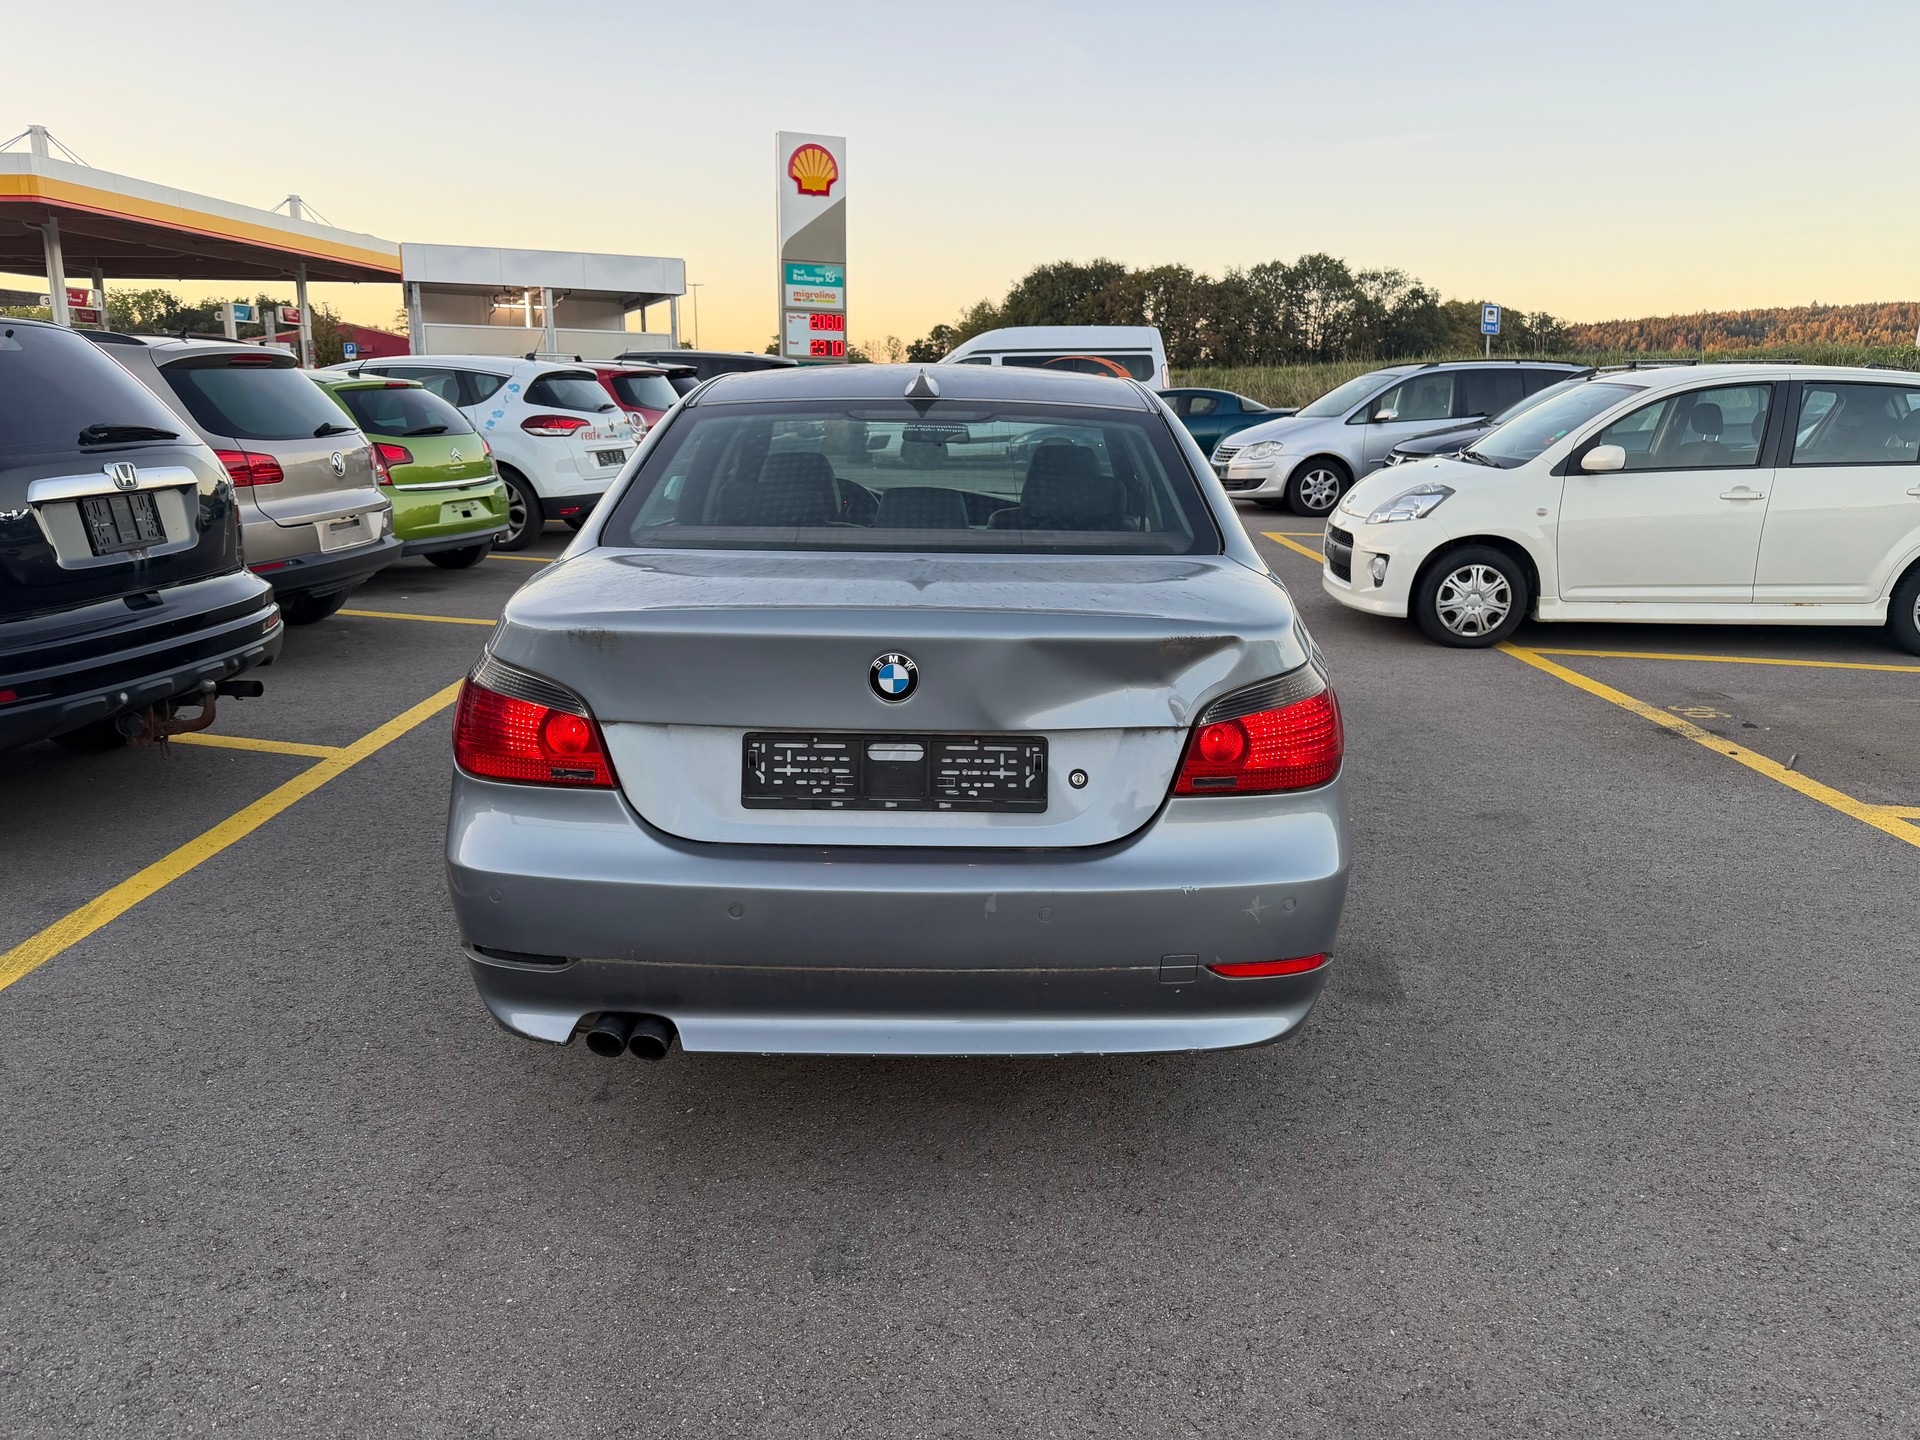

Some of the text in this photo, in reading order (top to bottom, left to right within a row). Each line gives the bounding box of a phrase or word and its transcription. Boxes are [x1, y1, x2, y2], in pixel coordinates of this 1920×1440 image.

[793, 274, 824, 283] Recharge
[793, 290, 836, 300] migrolino
[45, 297, 51, 305] 3
[346, 344, 354, 354] P
[873, 655, 915, 671] BMW
